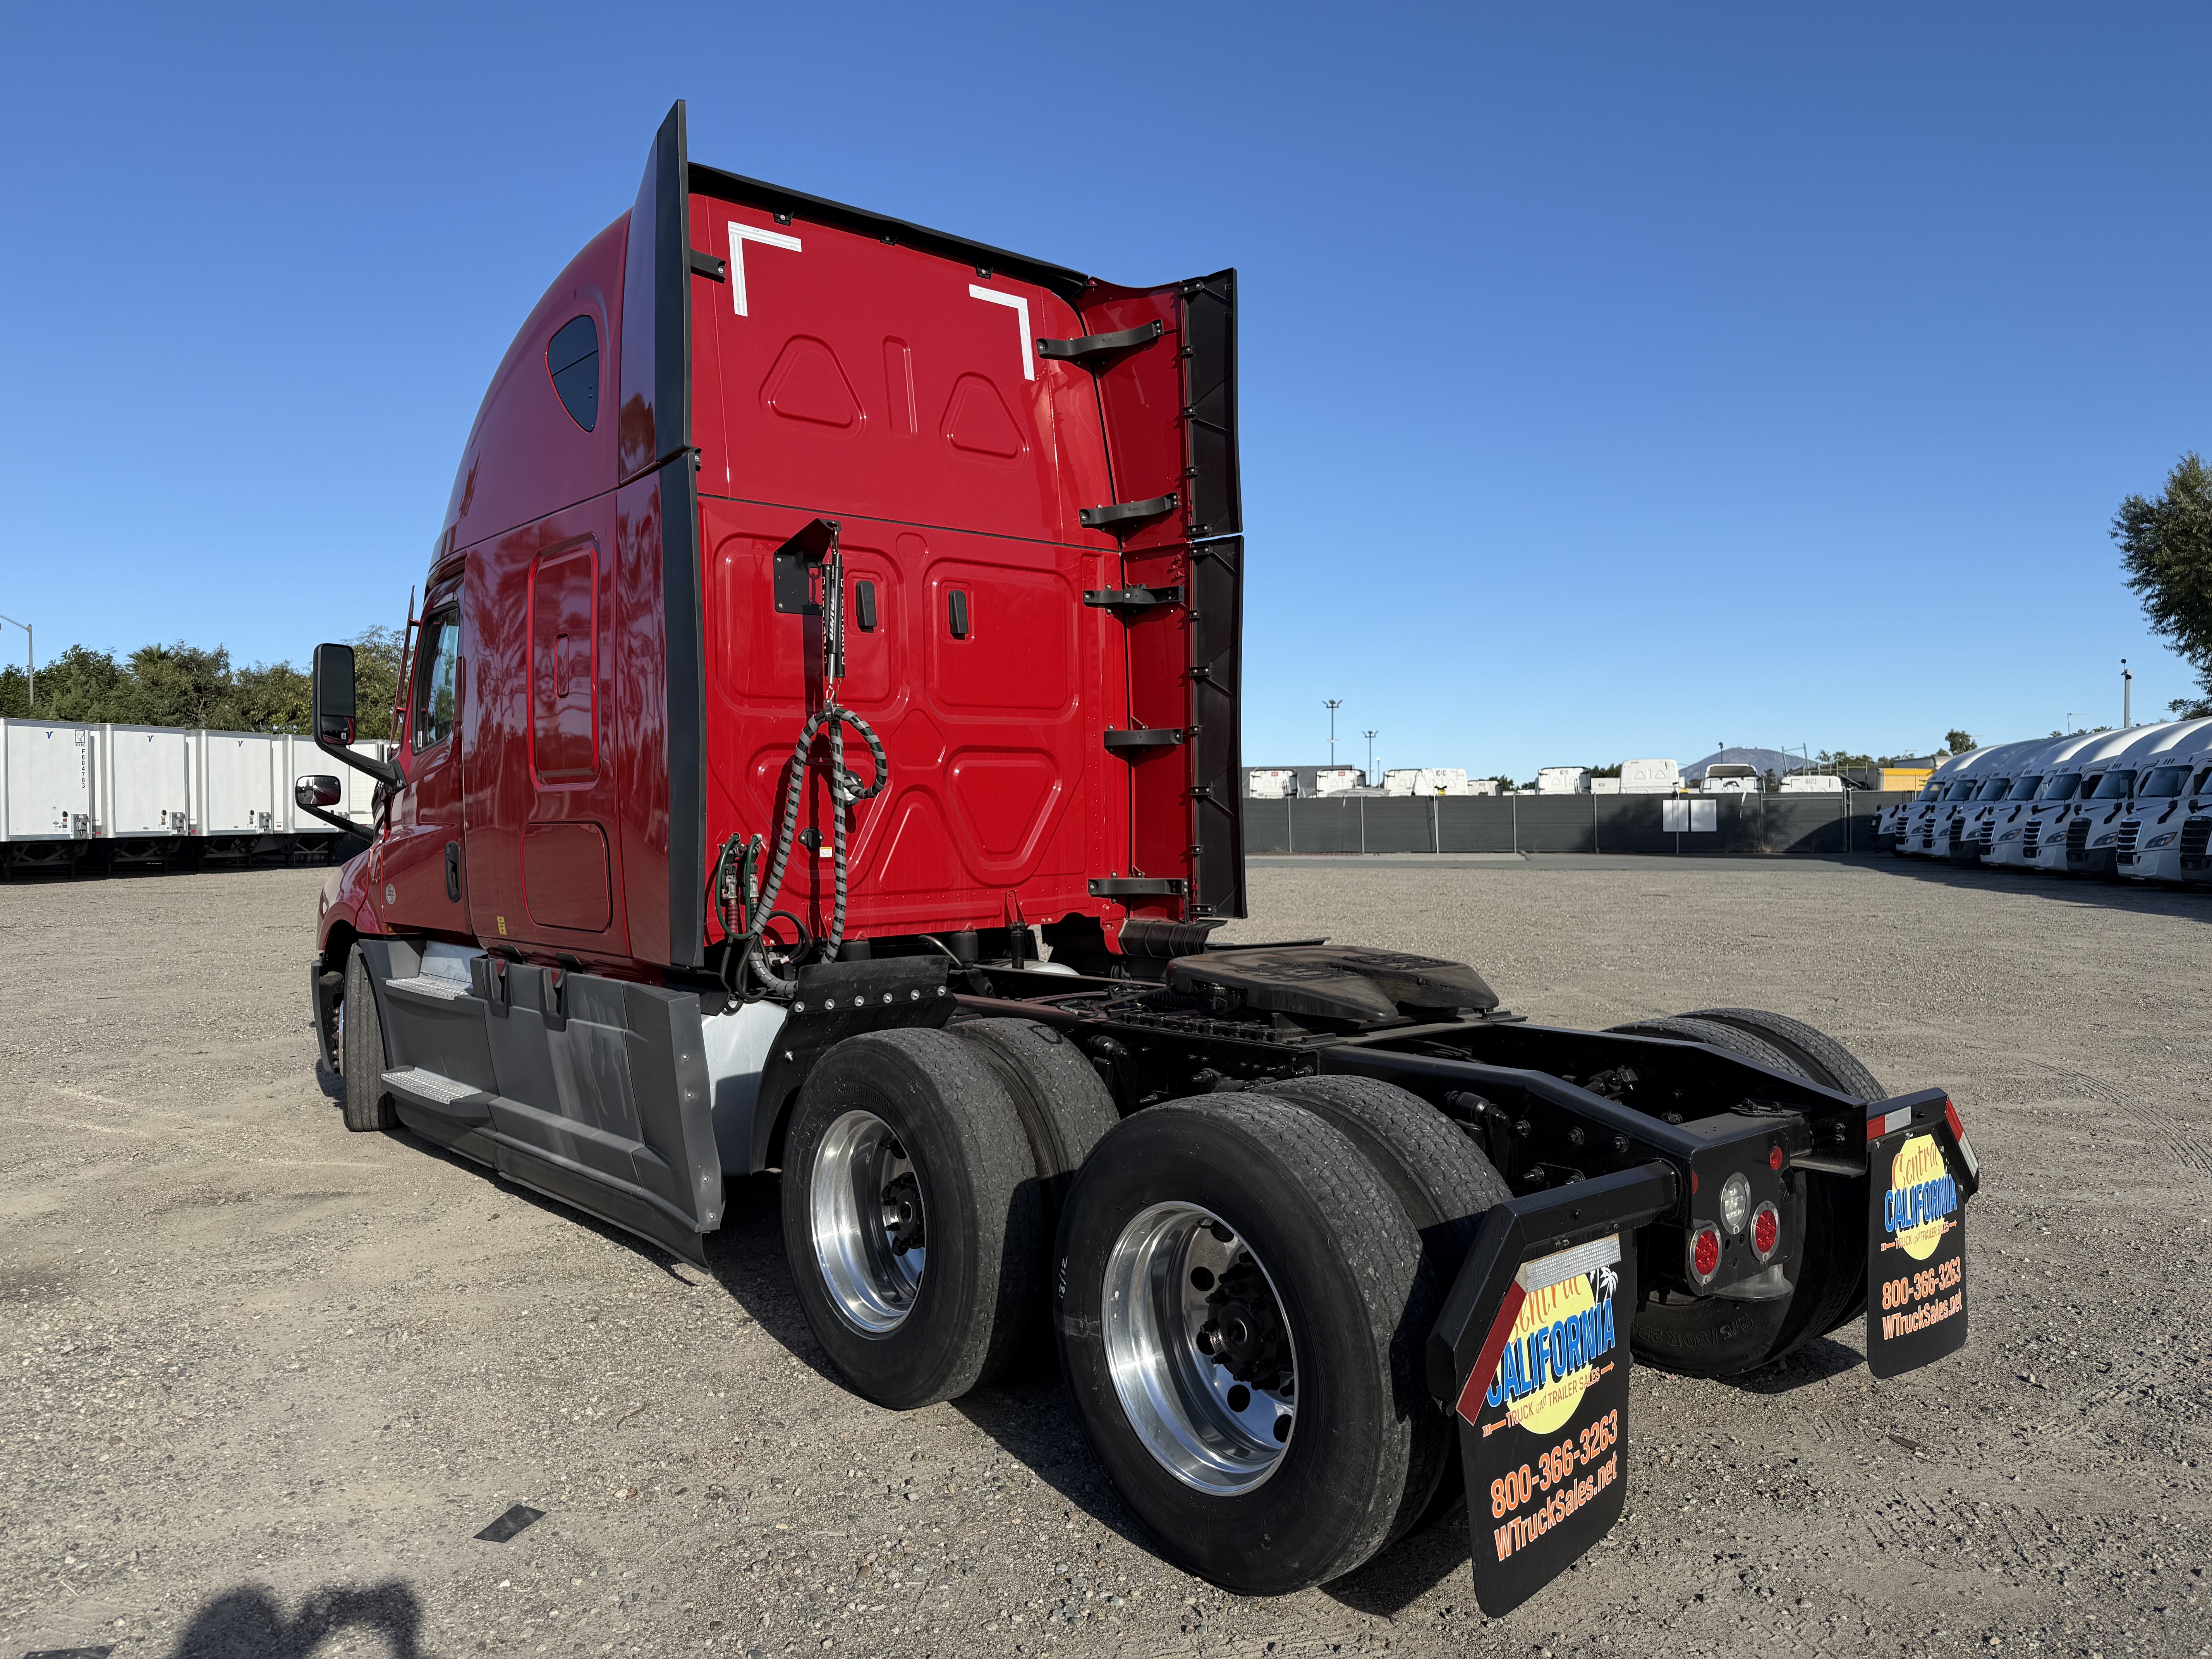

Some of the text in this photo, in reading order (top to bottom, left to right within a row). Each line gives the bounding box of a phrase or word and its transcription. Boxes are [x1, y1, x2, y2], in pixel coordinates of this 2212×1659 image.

[827, 1084, 895, 1117] BRIDGESTONE
[1885, 1174, 1958, 1233] CALIFORNIA
[1895, 1234, 1912, 1249] TRUCK
[1921, 1228, 1937, 1242] TRAILER
[1937, 1221, 1949, 1235] SALES
[1882, 1256, 1961, 1310] 800-366-3263
[1882, 1288, 1962, 1340] WTruckSales.net
[1505, 1367, 1600, 1428] TRUCK and TRAILER SALES
[1491, 1409, 1618, 1519] 800-366-3263
[1494, 1450, 1617, 1562] WTruckSales.net
